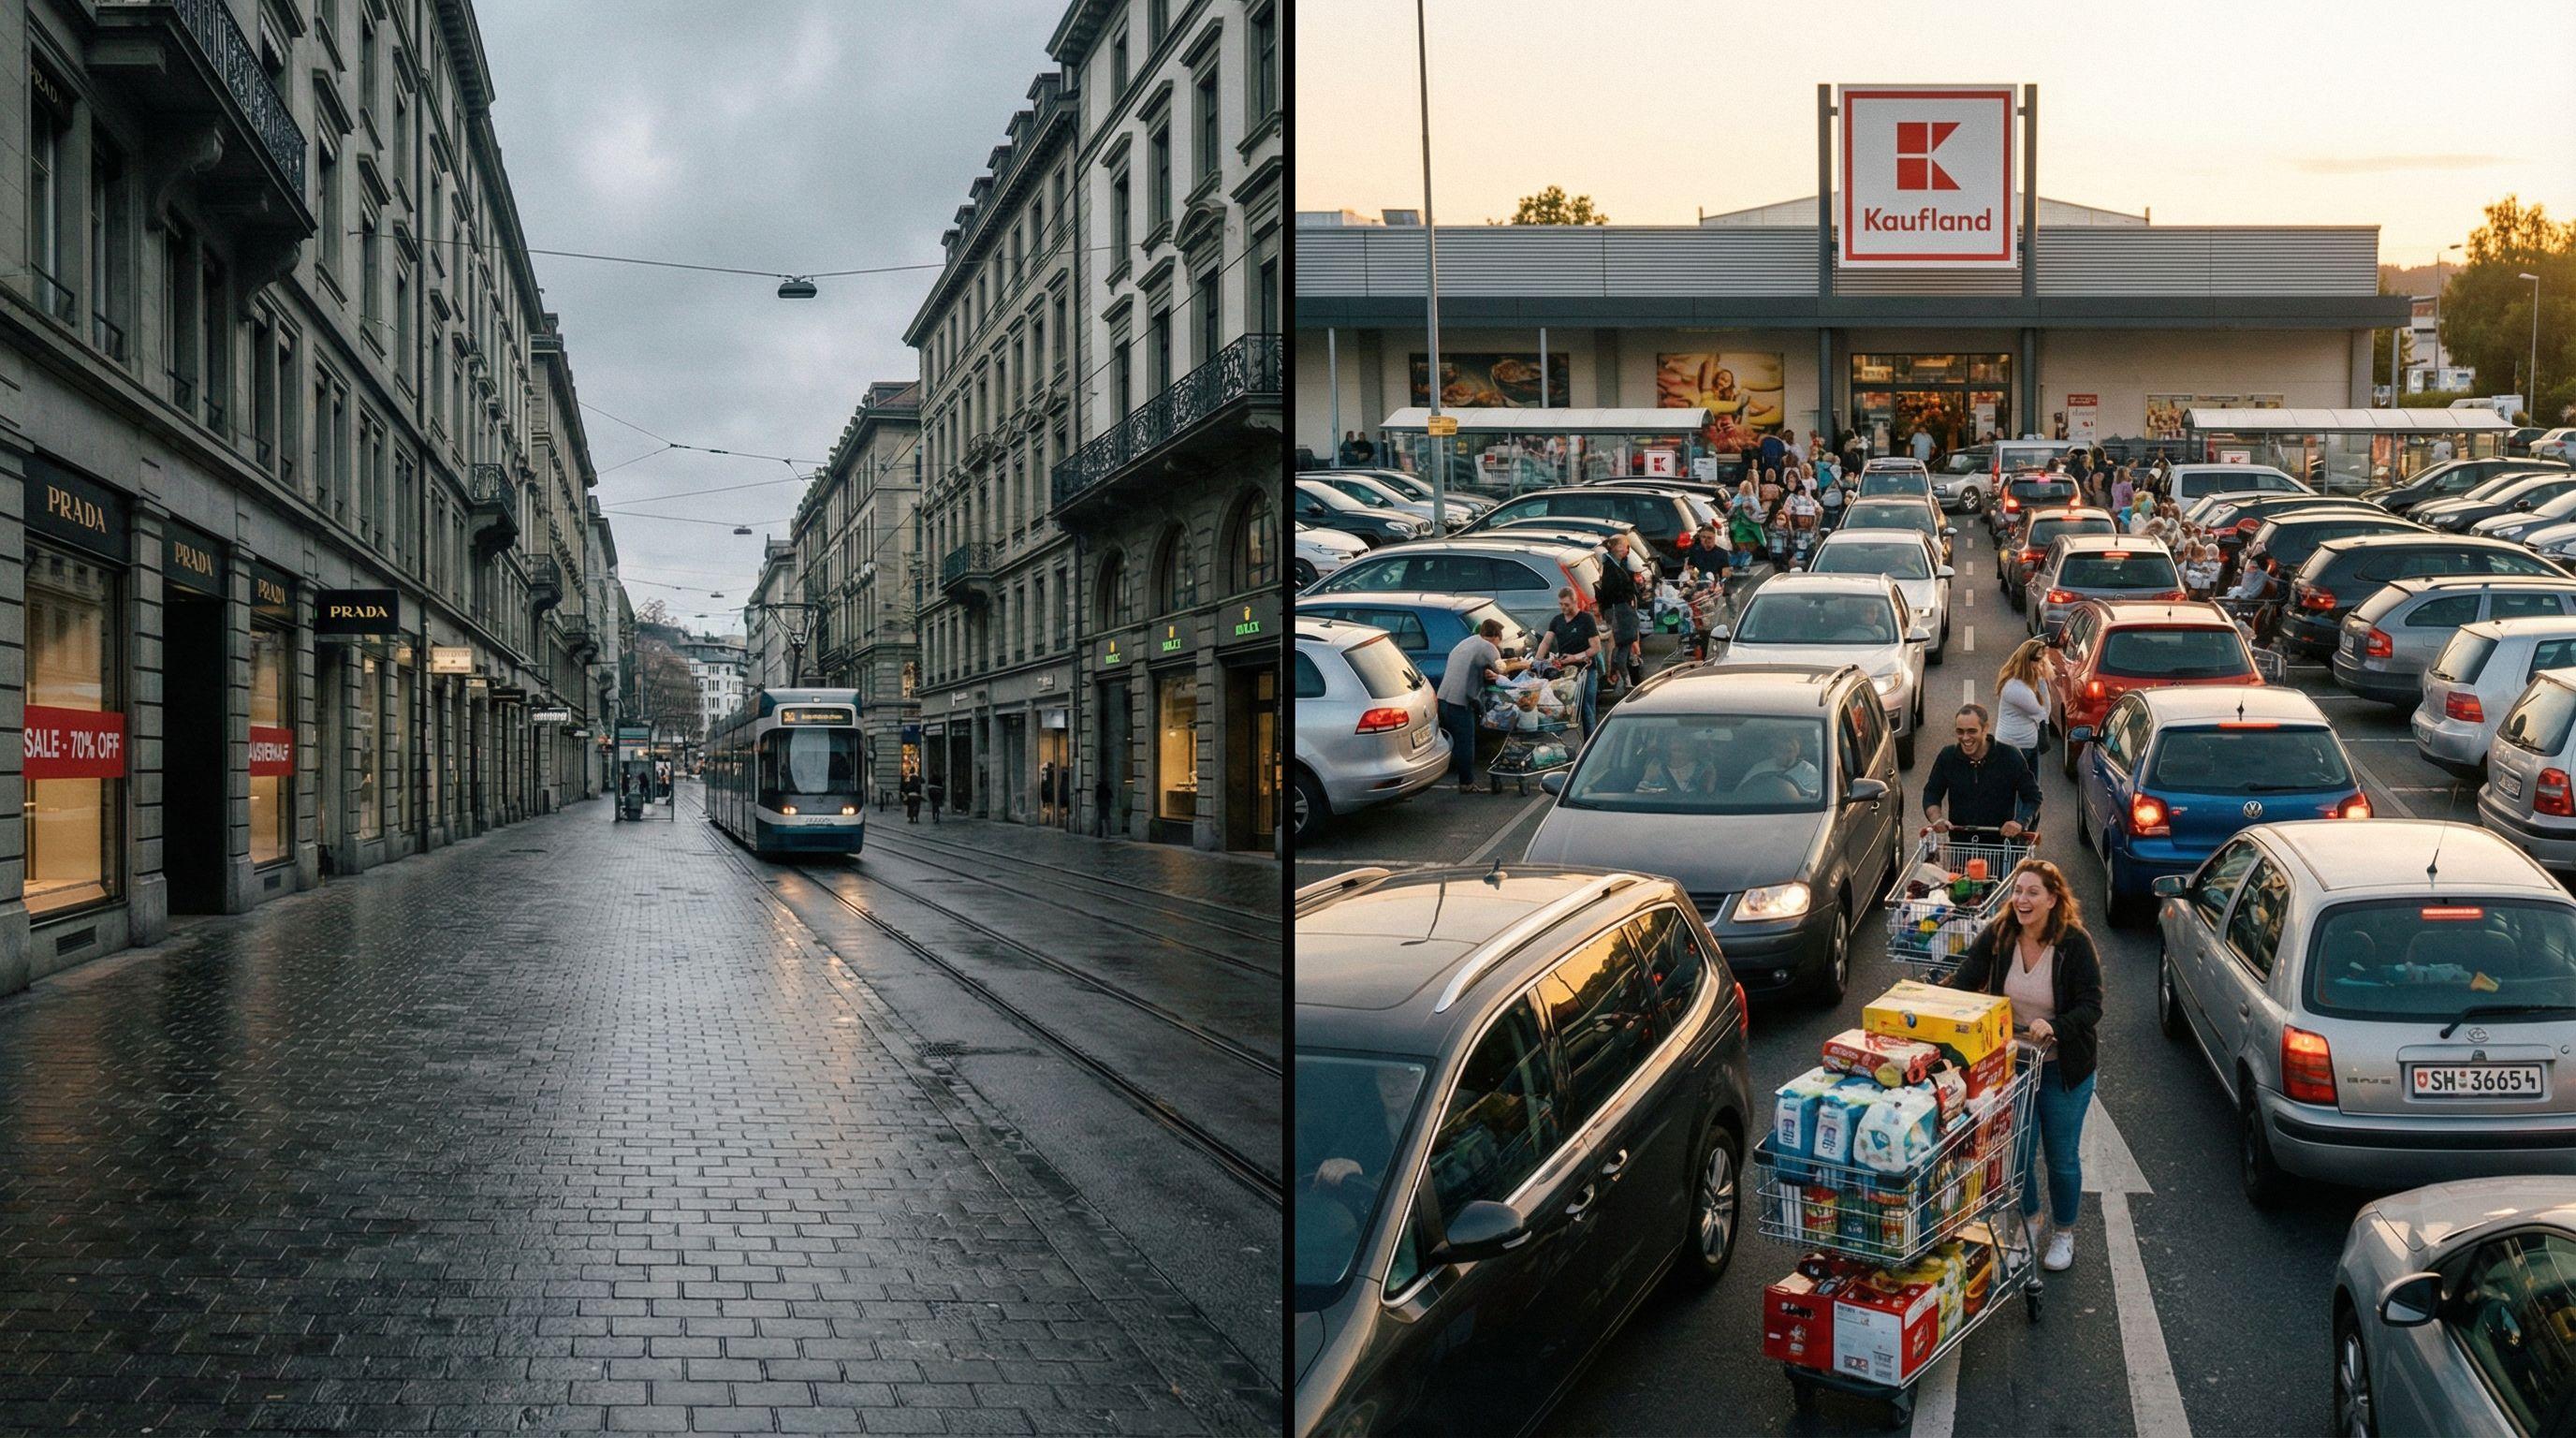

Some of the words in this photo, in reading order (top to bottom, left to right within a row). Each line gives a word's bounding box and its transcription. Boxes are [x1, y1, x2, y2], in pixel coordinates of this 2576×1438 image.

[1864, 208, 1992, 231] Kaufland
[47, 484, 107, 534] PRADA
[174, 541, 213, 577] PRADA
[257, 579, 286, 607] PRADA
[329, 606, 388, 619] PRADA
[23, 727, 60, 758] SALE
[70, 730, 95, 759] 70%
[97, 732, 120, 759] OFF
[2431, 1070, 2456, 1091] SH
